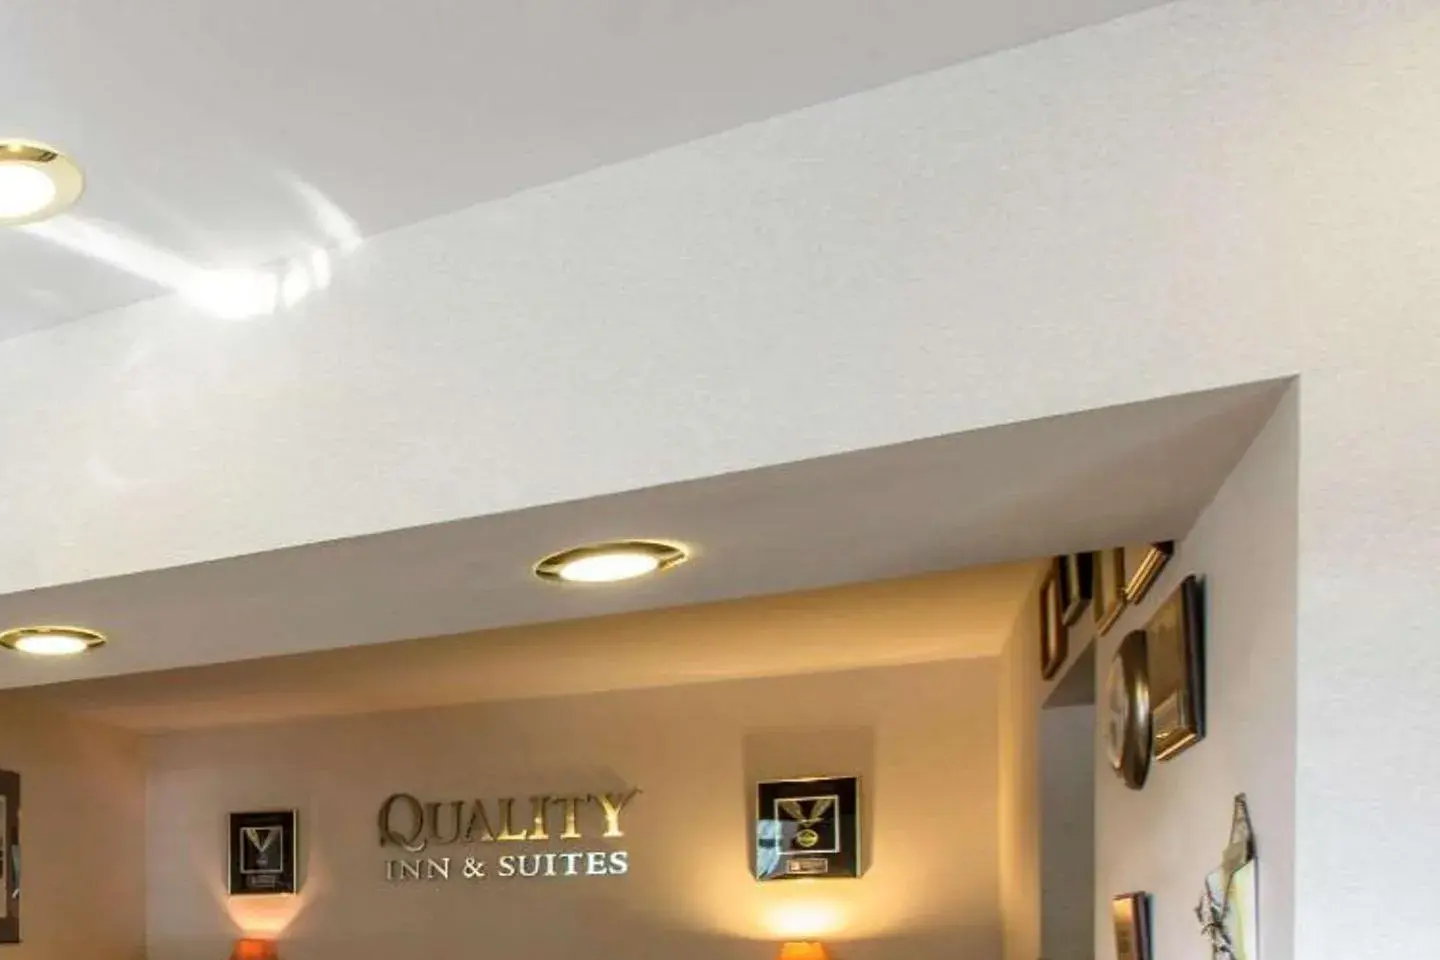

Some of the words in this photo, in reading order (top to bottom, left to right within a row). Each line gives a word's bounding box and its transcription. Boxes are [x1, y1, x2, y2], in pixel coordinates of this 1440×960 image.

[378, 786, 642, 852] QUALITY
[386, 857, 450, 880] INN
[463, 857, 485, 879] &
[498, 851, 629, 877] SUITES
